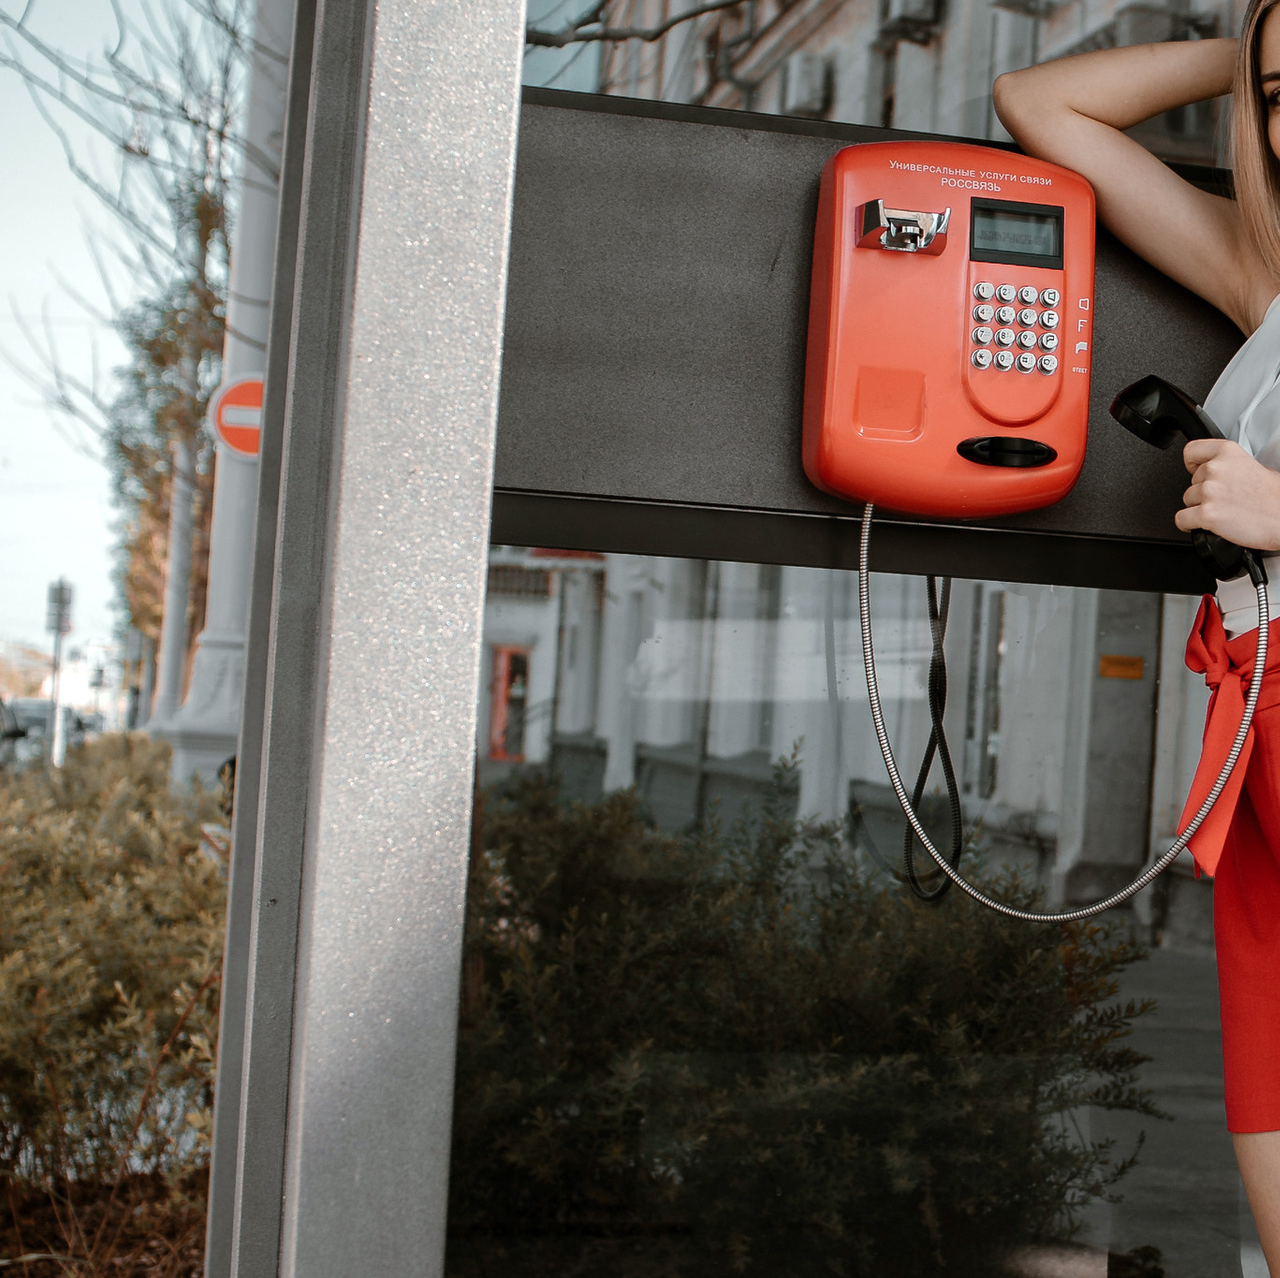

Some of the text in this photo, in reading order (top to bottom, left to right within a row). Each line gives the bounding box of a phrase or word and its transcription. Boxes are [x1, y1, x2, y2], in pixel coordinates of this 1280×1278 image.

[941, 177, 1002, 192] РОССВЯЗЬ
[980, 171, 1017, 182] УСЛУГИ
[1020, 175, 1052, 186] СВЯЗИ
[1047, 313, 1055, 323] F
[1078, 319, 1088, 333] F
